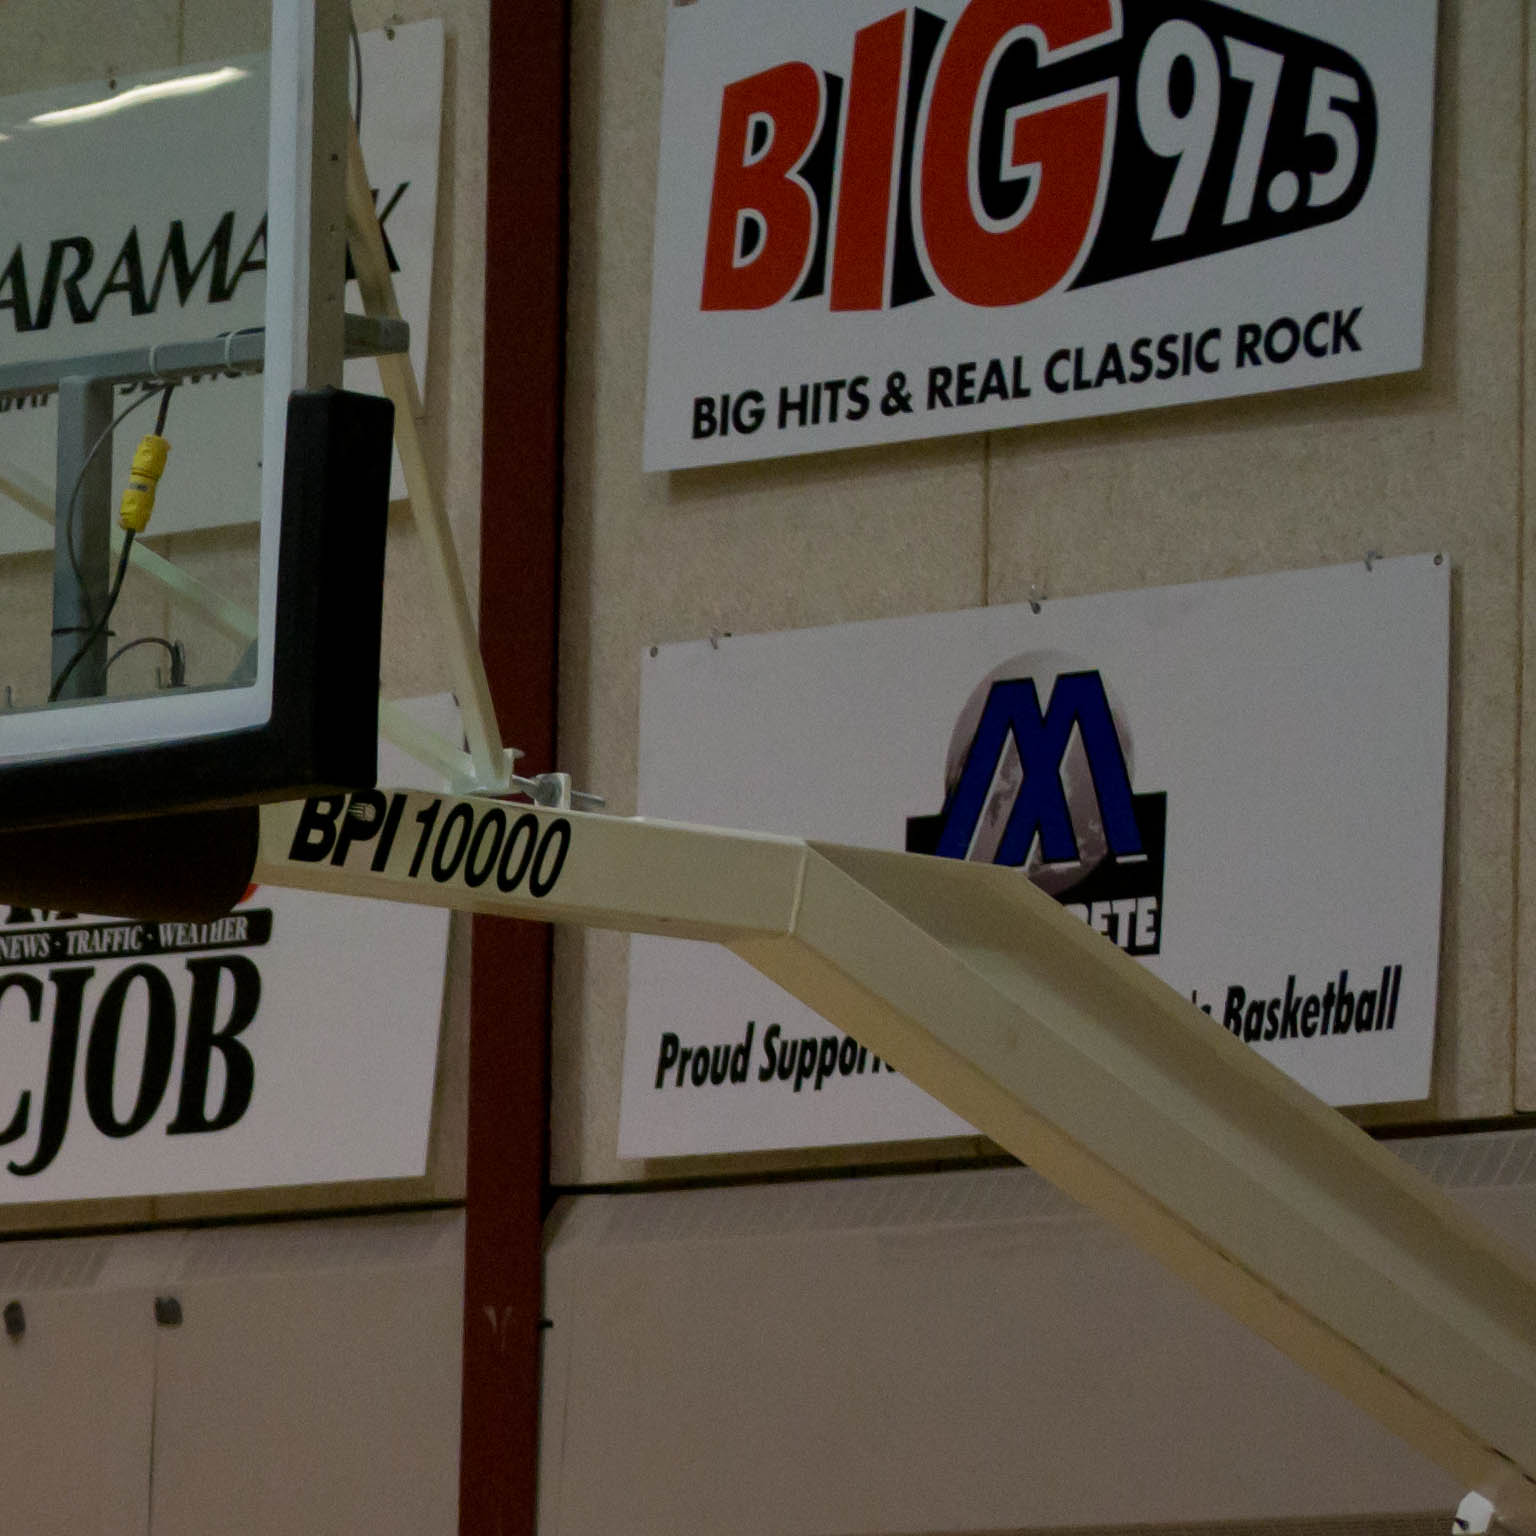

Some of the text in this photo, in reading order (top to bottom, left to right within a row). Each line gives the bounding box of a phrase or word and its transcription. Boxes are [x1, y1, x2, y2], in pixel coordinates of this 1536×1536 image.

[699, 0, 1362, 312] BIG 97.5
[691, 306, 1364, 440] BIG HITS & REAL CLASSIC ROCK
[289, 789, 571, 898] BPI 10000
[64, 923, 145, 958] TRAFFIC
[157, 915, 249, 949] WEATHER
[655, 1020, 755, 1089] Proud
[1224, 965, 1402, 1043] Basketball
